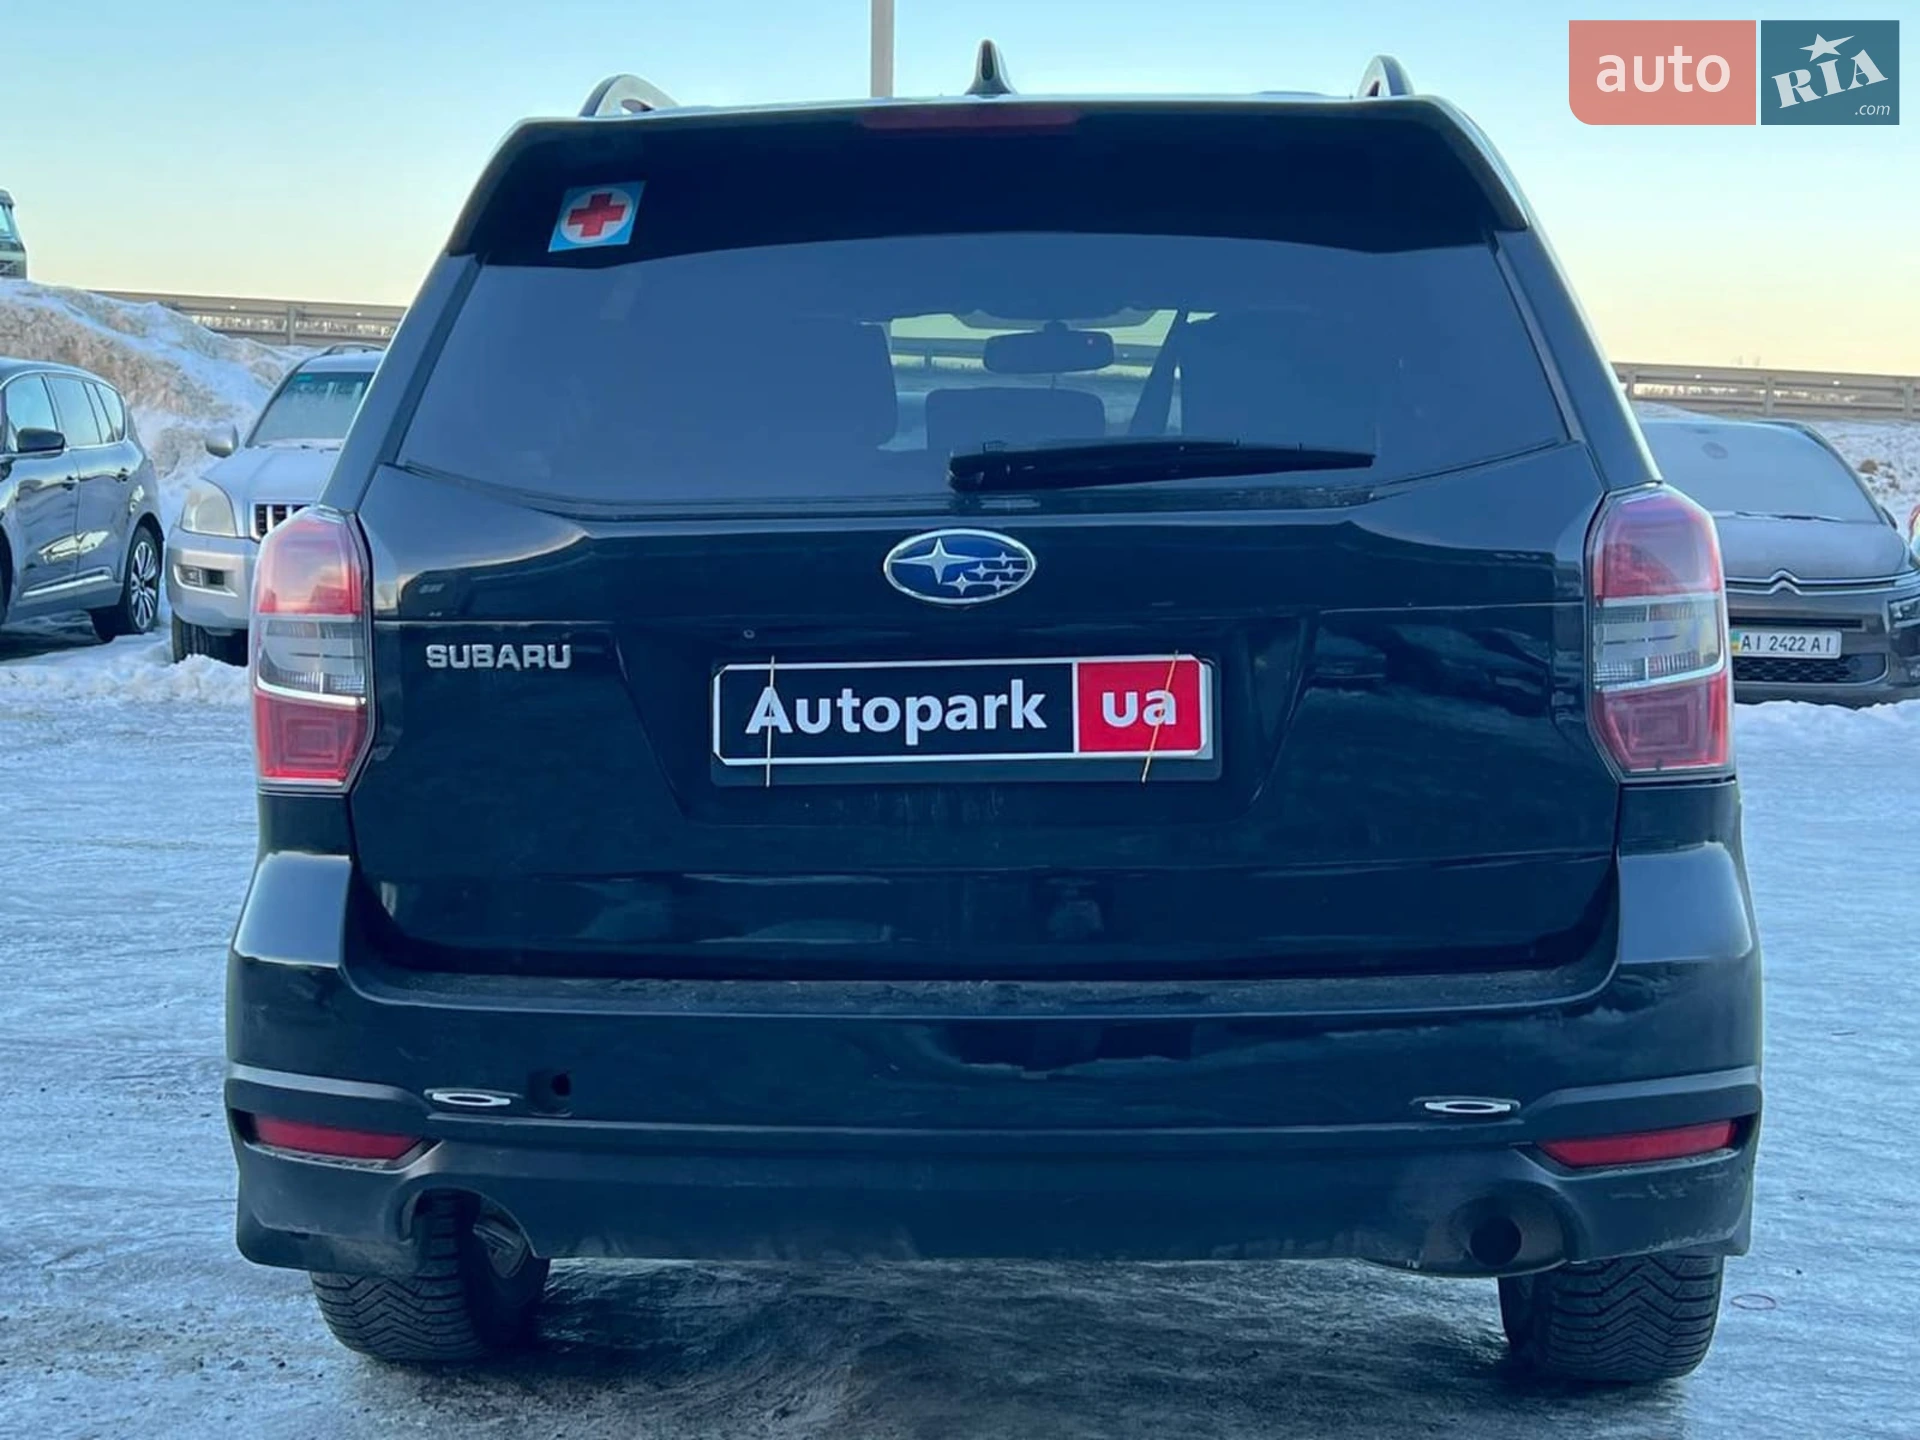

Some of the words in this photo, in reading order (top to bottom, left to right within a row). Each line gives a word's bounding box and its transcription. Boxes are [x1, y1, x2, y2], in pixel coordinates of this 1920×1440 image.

[426, 643, 572, 671] SUBARU
[1741, 635, 1761, 651] AI
[1769, 635, 1805, 652] 2422
[1811, 636, 1831, 653] AI
[745, 679, 1047, 746] Autopark
[1102, 688, 1177, 728] ua
